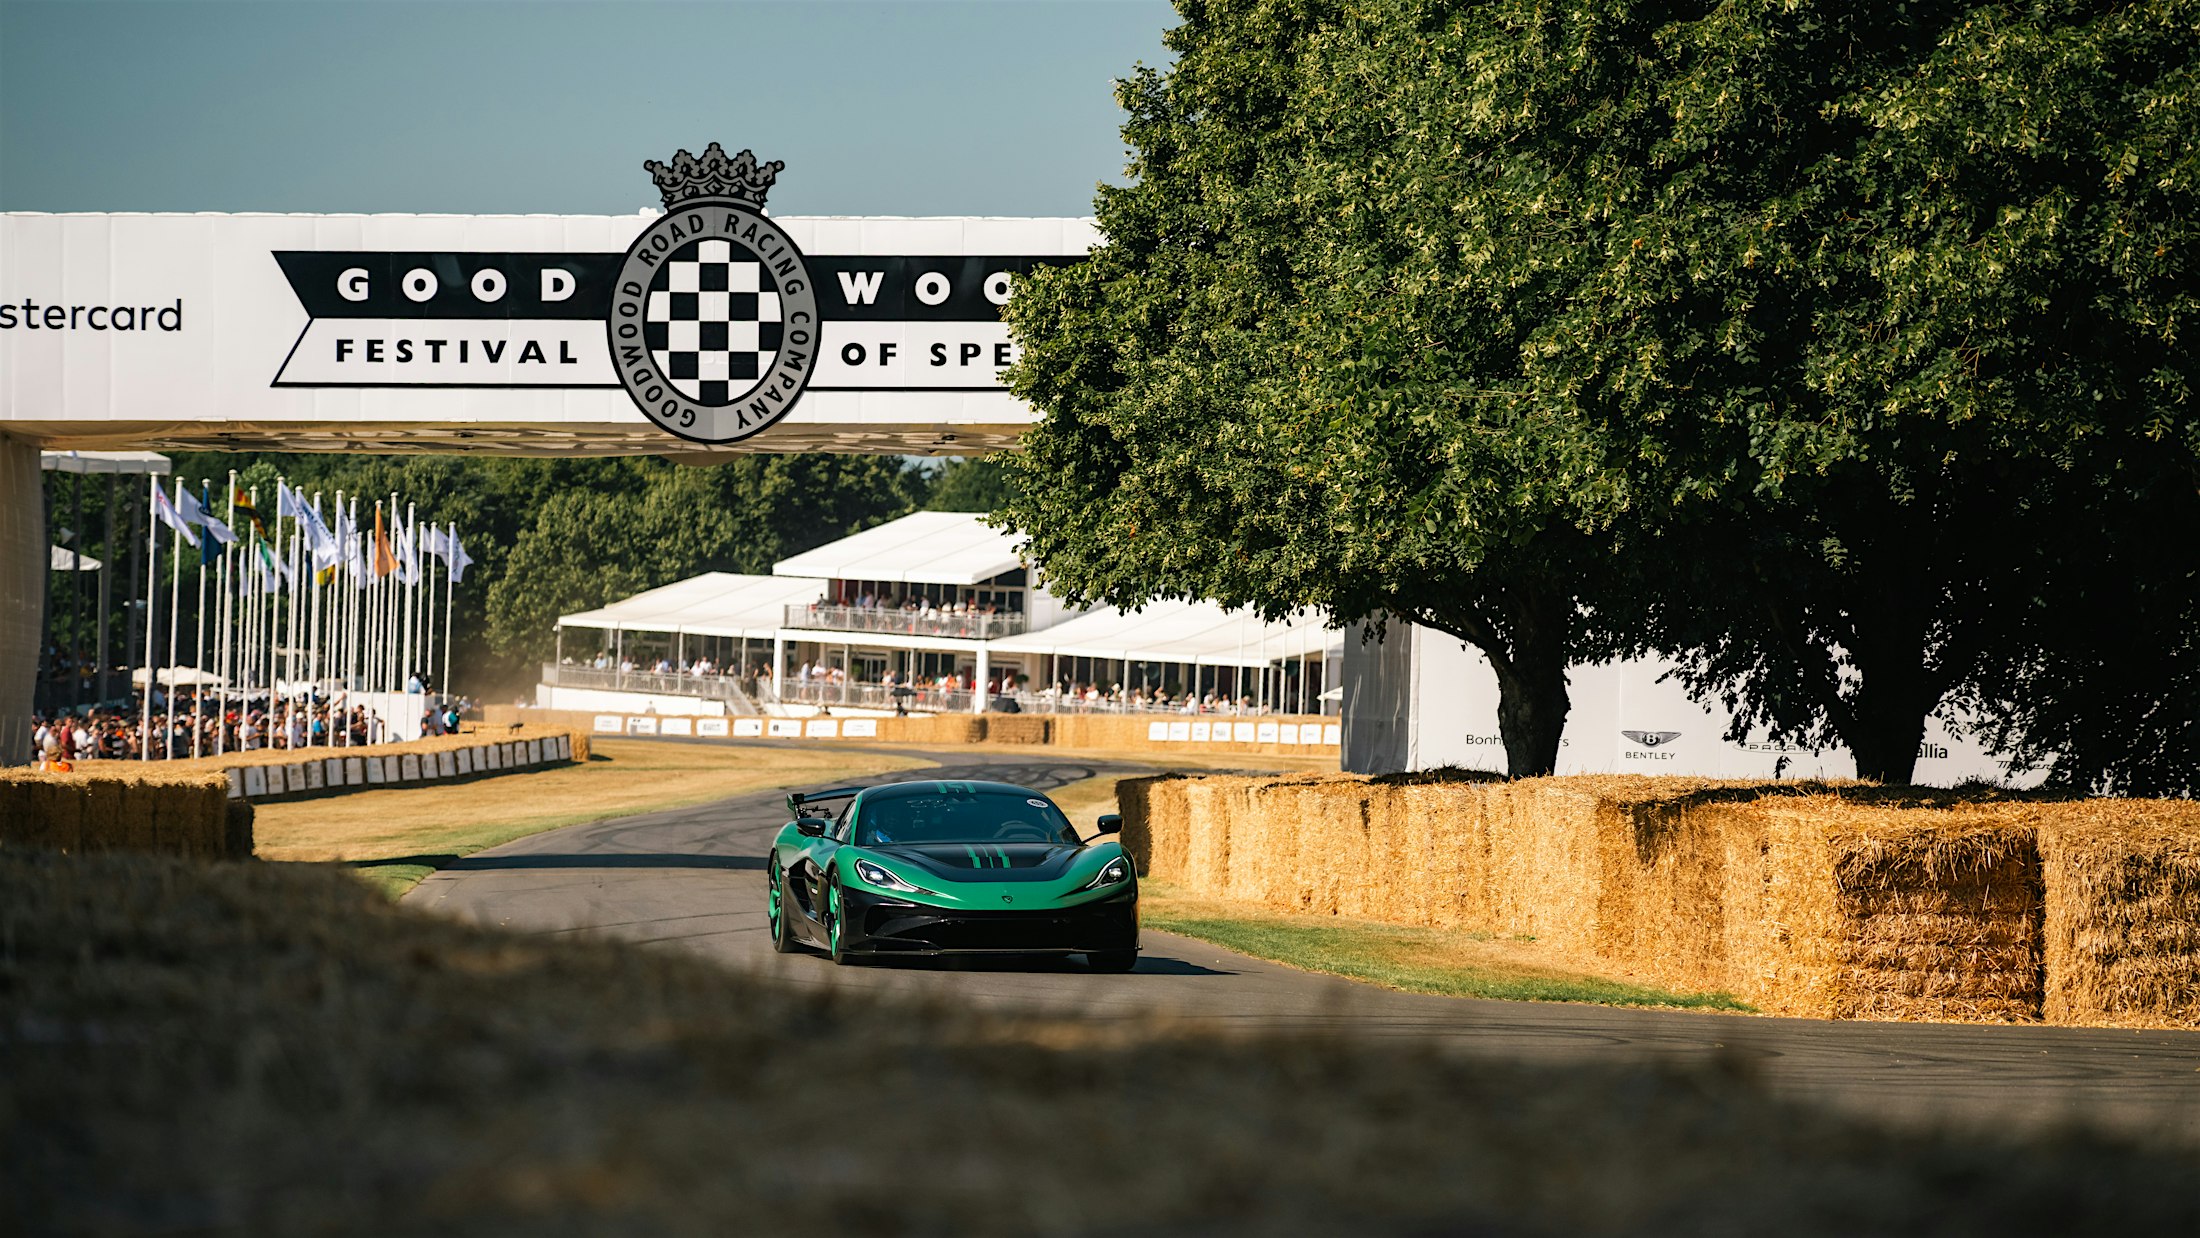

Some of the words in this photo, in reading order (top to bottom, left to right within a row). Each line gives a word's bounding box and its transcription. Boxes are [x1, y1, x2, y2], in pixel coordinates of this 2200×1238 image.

[637, 214, 704, 267] ROAD
[724, 213, 805, 296] RACING
[337, 268, 576, 302] GOOD
[837, 271, 1013, 305] WOO
[0, 298, 182, 331] stercard
[336, 339, 577, 364] FESTIVAL
[841, 342, 897, 367] OF
[930, 342, 1012, 367] SPE
[618, 281, 696, 428] GOODWOOD
[736, 311, 810, 430] COMPANY
[1625, 751, 1676, 760] BENTLEY
[1916, 743, 1948, 758] allia
